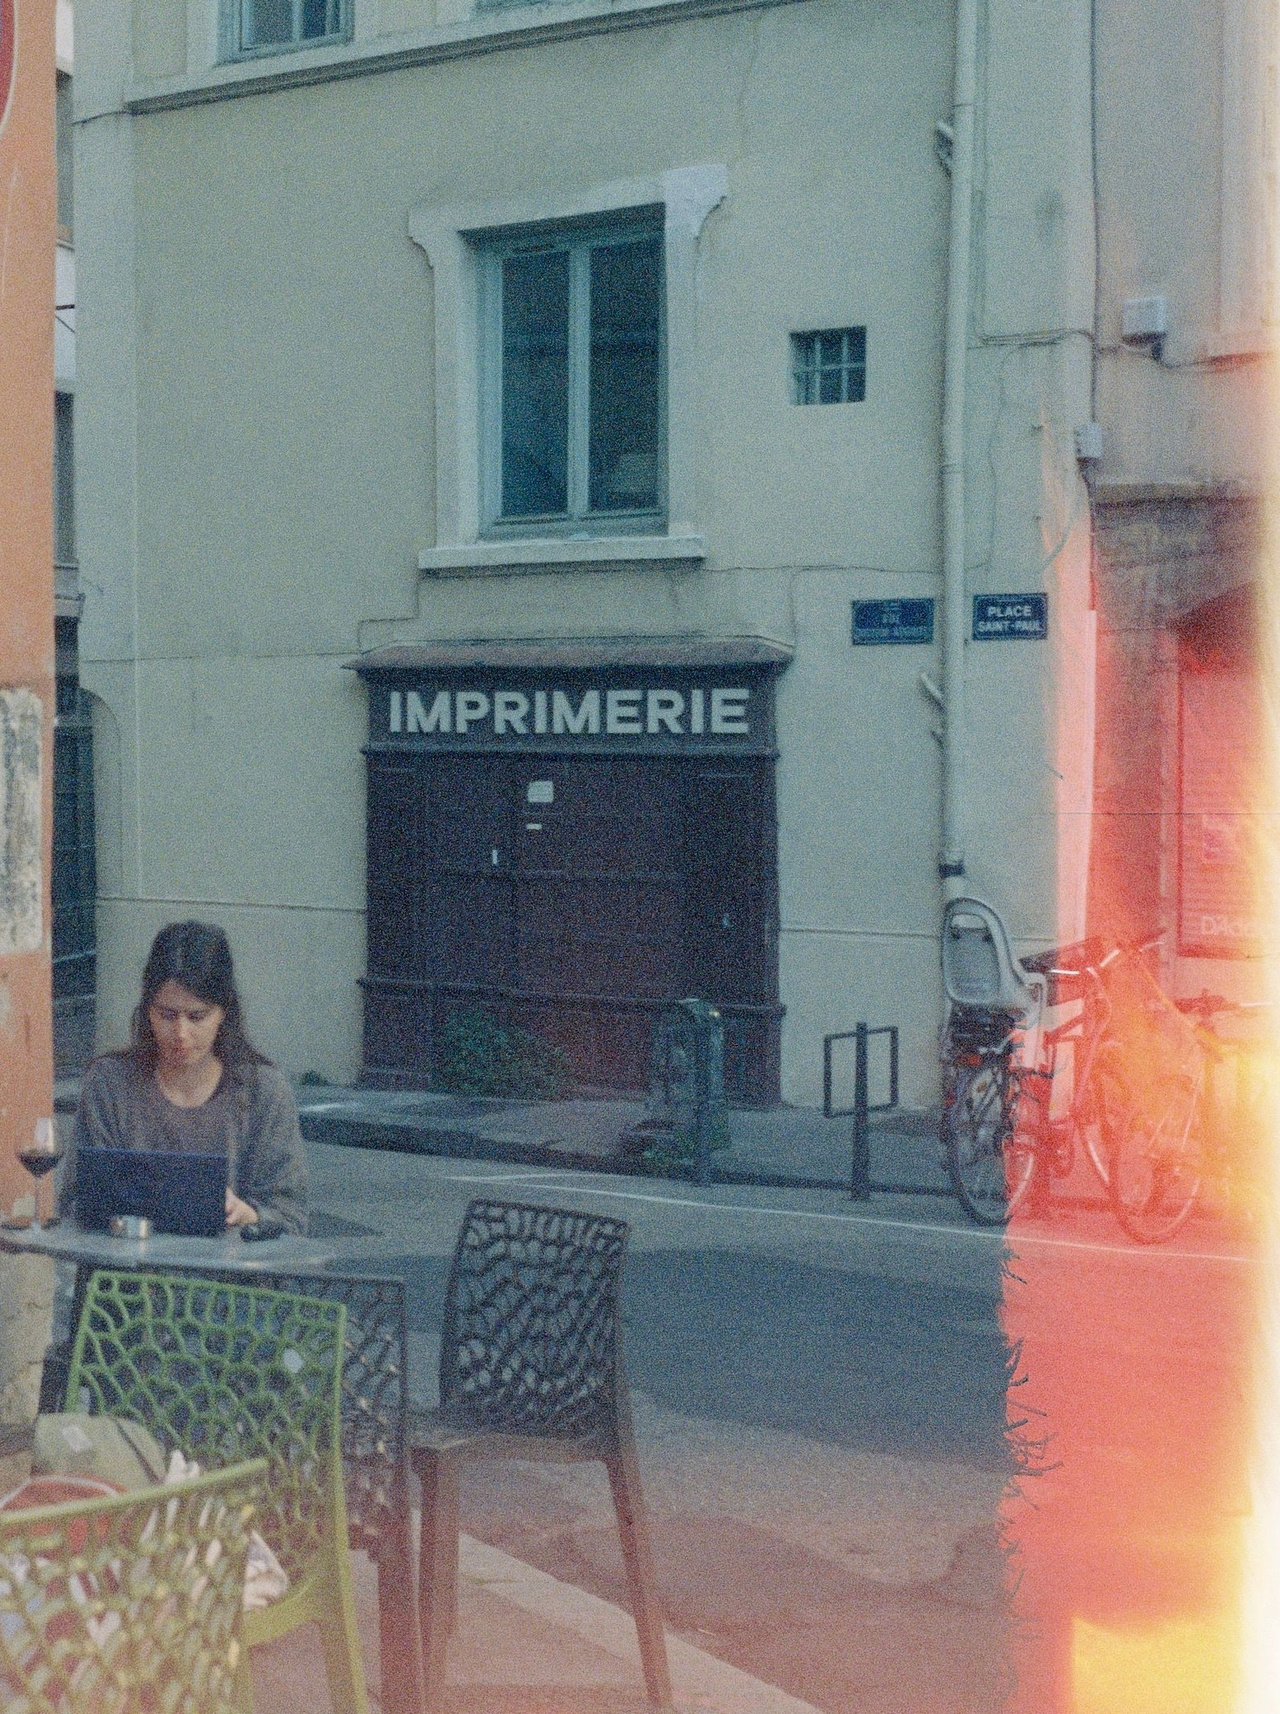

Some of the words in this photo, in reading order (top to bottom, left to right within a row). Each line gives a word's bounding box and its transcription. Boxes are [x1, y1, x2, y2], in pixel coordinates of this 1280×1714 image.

[987, 605, 1032, 618] PLACE
[977, 620, 1043, 632] SAINT-PAUL
[389, 688, 750, 735] IMPRIMERIE
